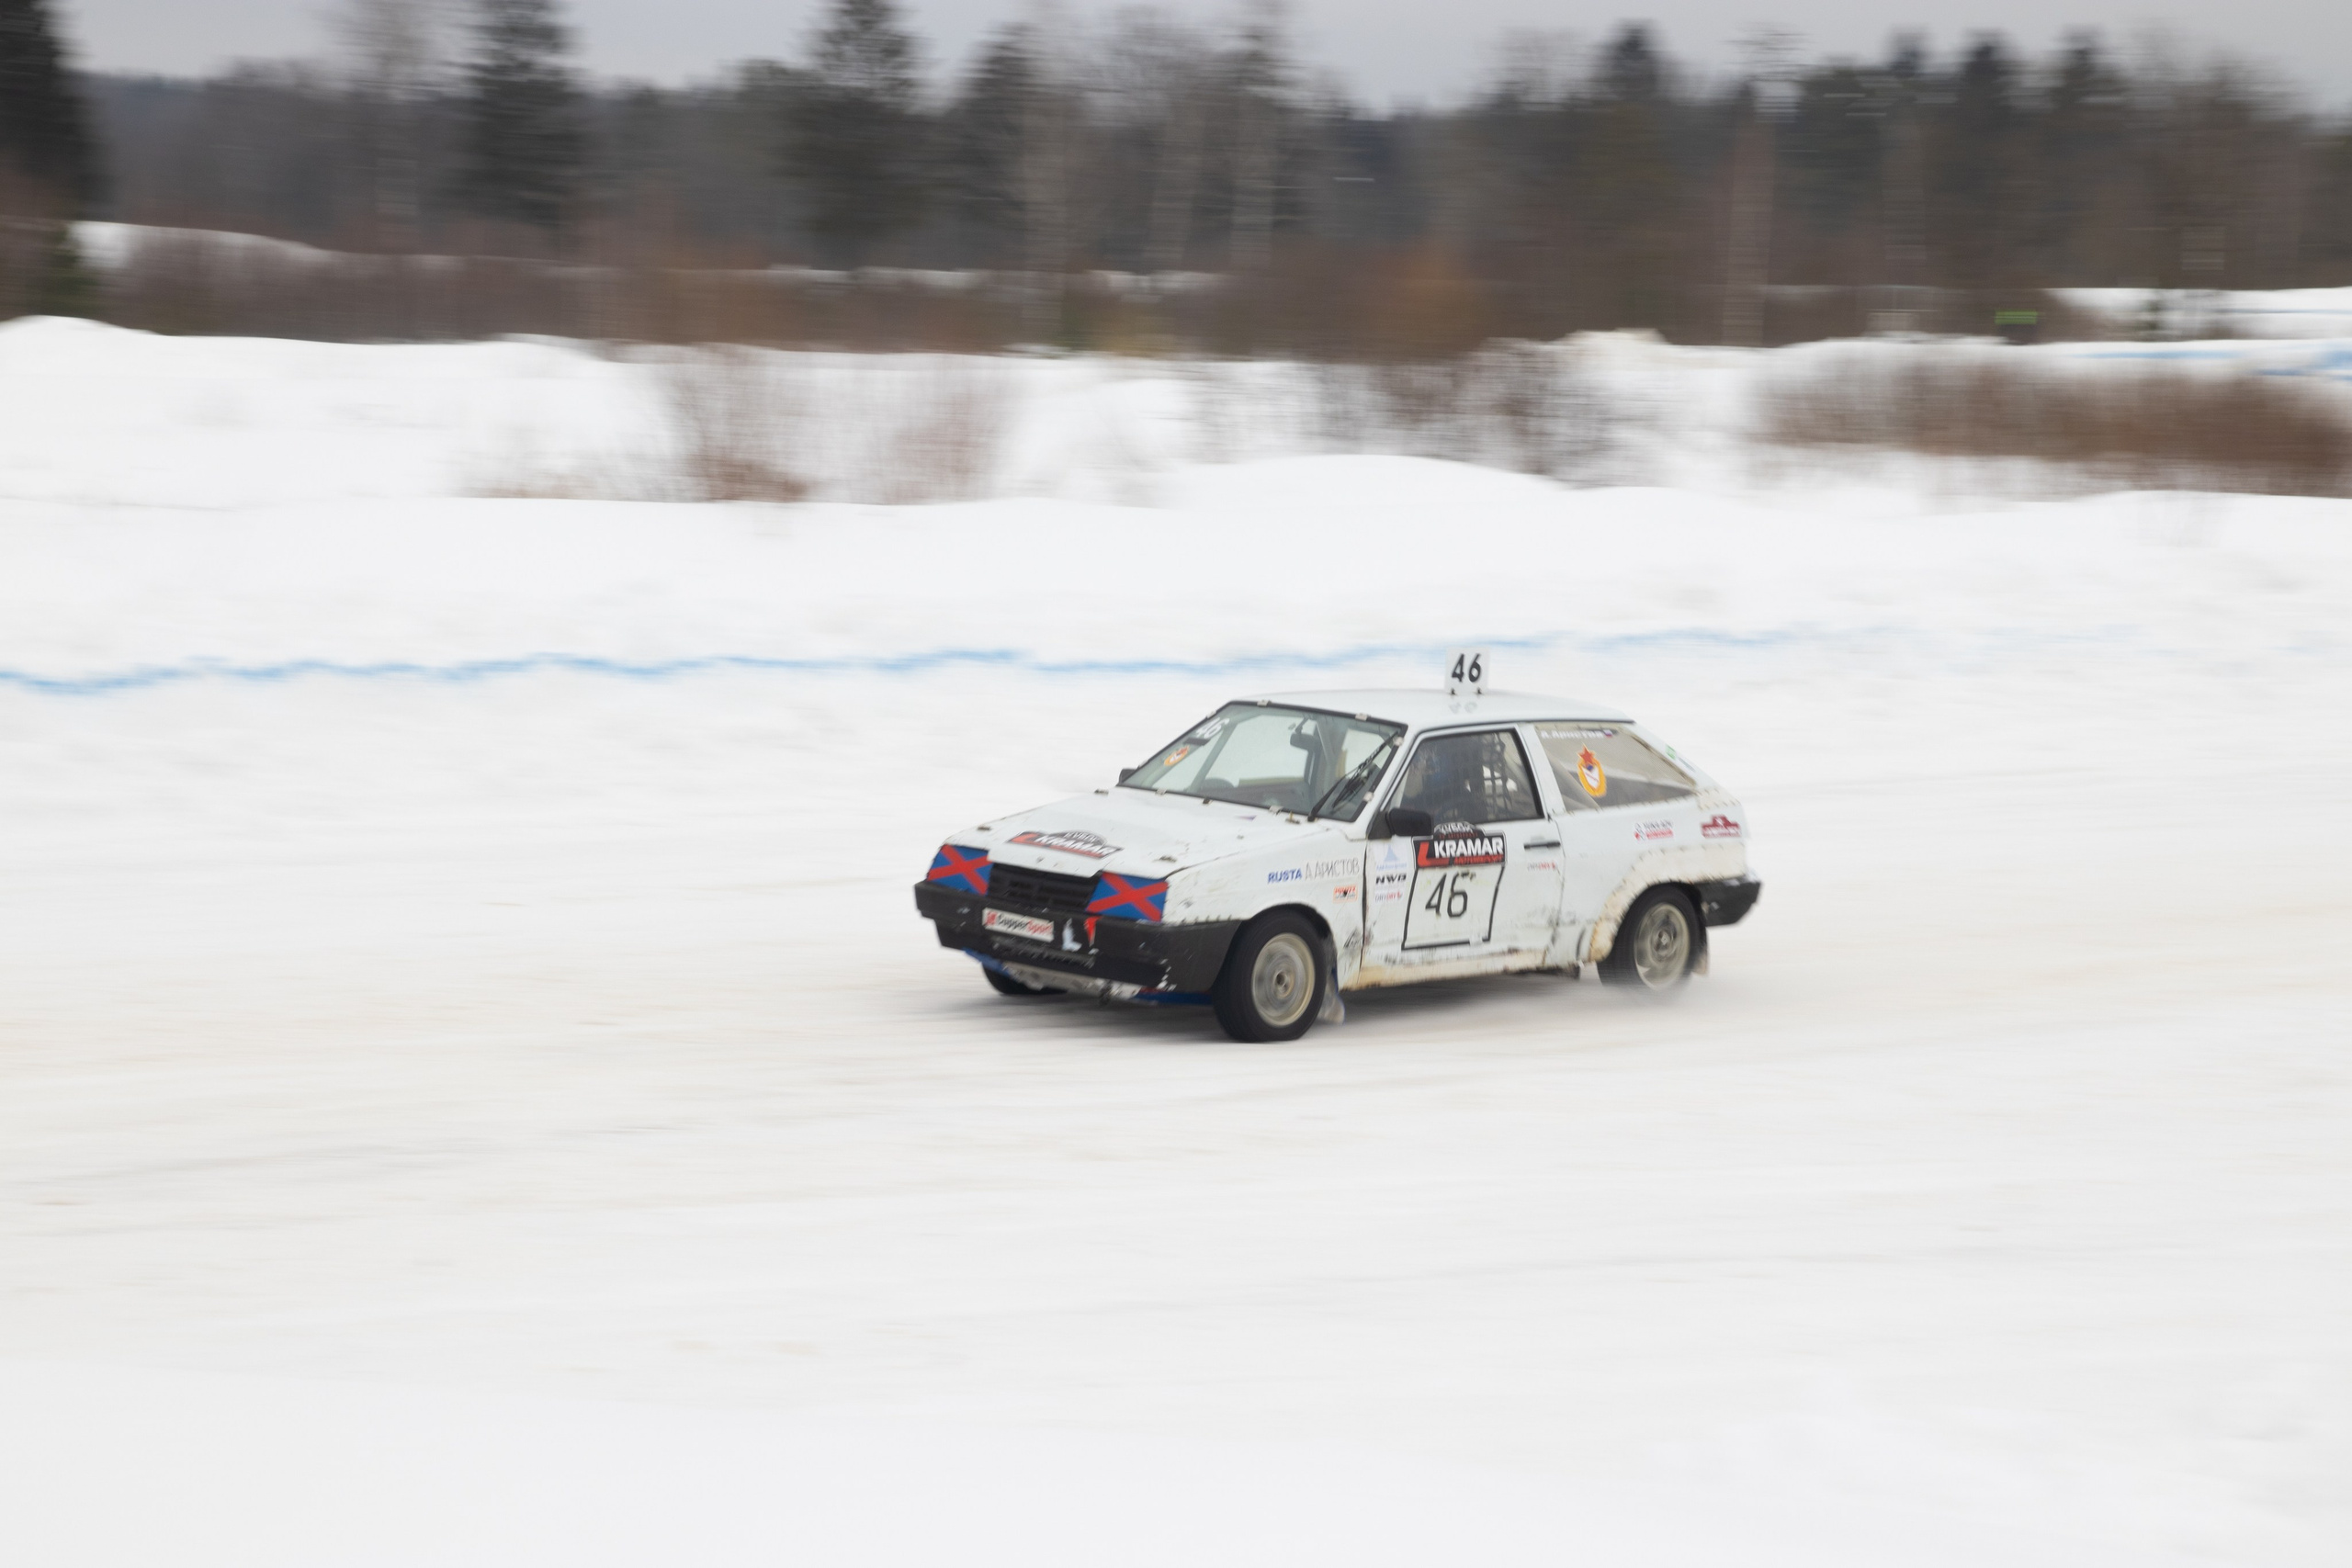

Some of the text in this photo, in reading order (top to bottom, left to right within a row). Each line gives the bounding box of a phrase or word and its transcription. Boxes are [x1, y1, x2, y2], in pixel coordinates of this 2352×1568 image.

[1451, 653, 1481, 683] 46
[1195, 716, 1230, 739] 46
[1033, 834, 1119, 855] KRAMAR
[1433, 837, 1504, 859] KRAMAR
[1268, 868, 1303, 883] RUSTA
[1315, 858, 1360, 879] АРИСТОВ
[1425, 872, 1469, 918] 46
